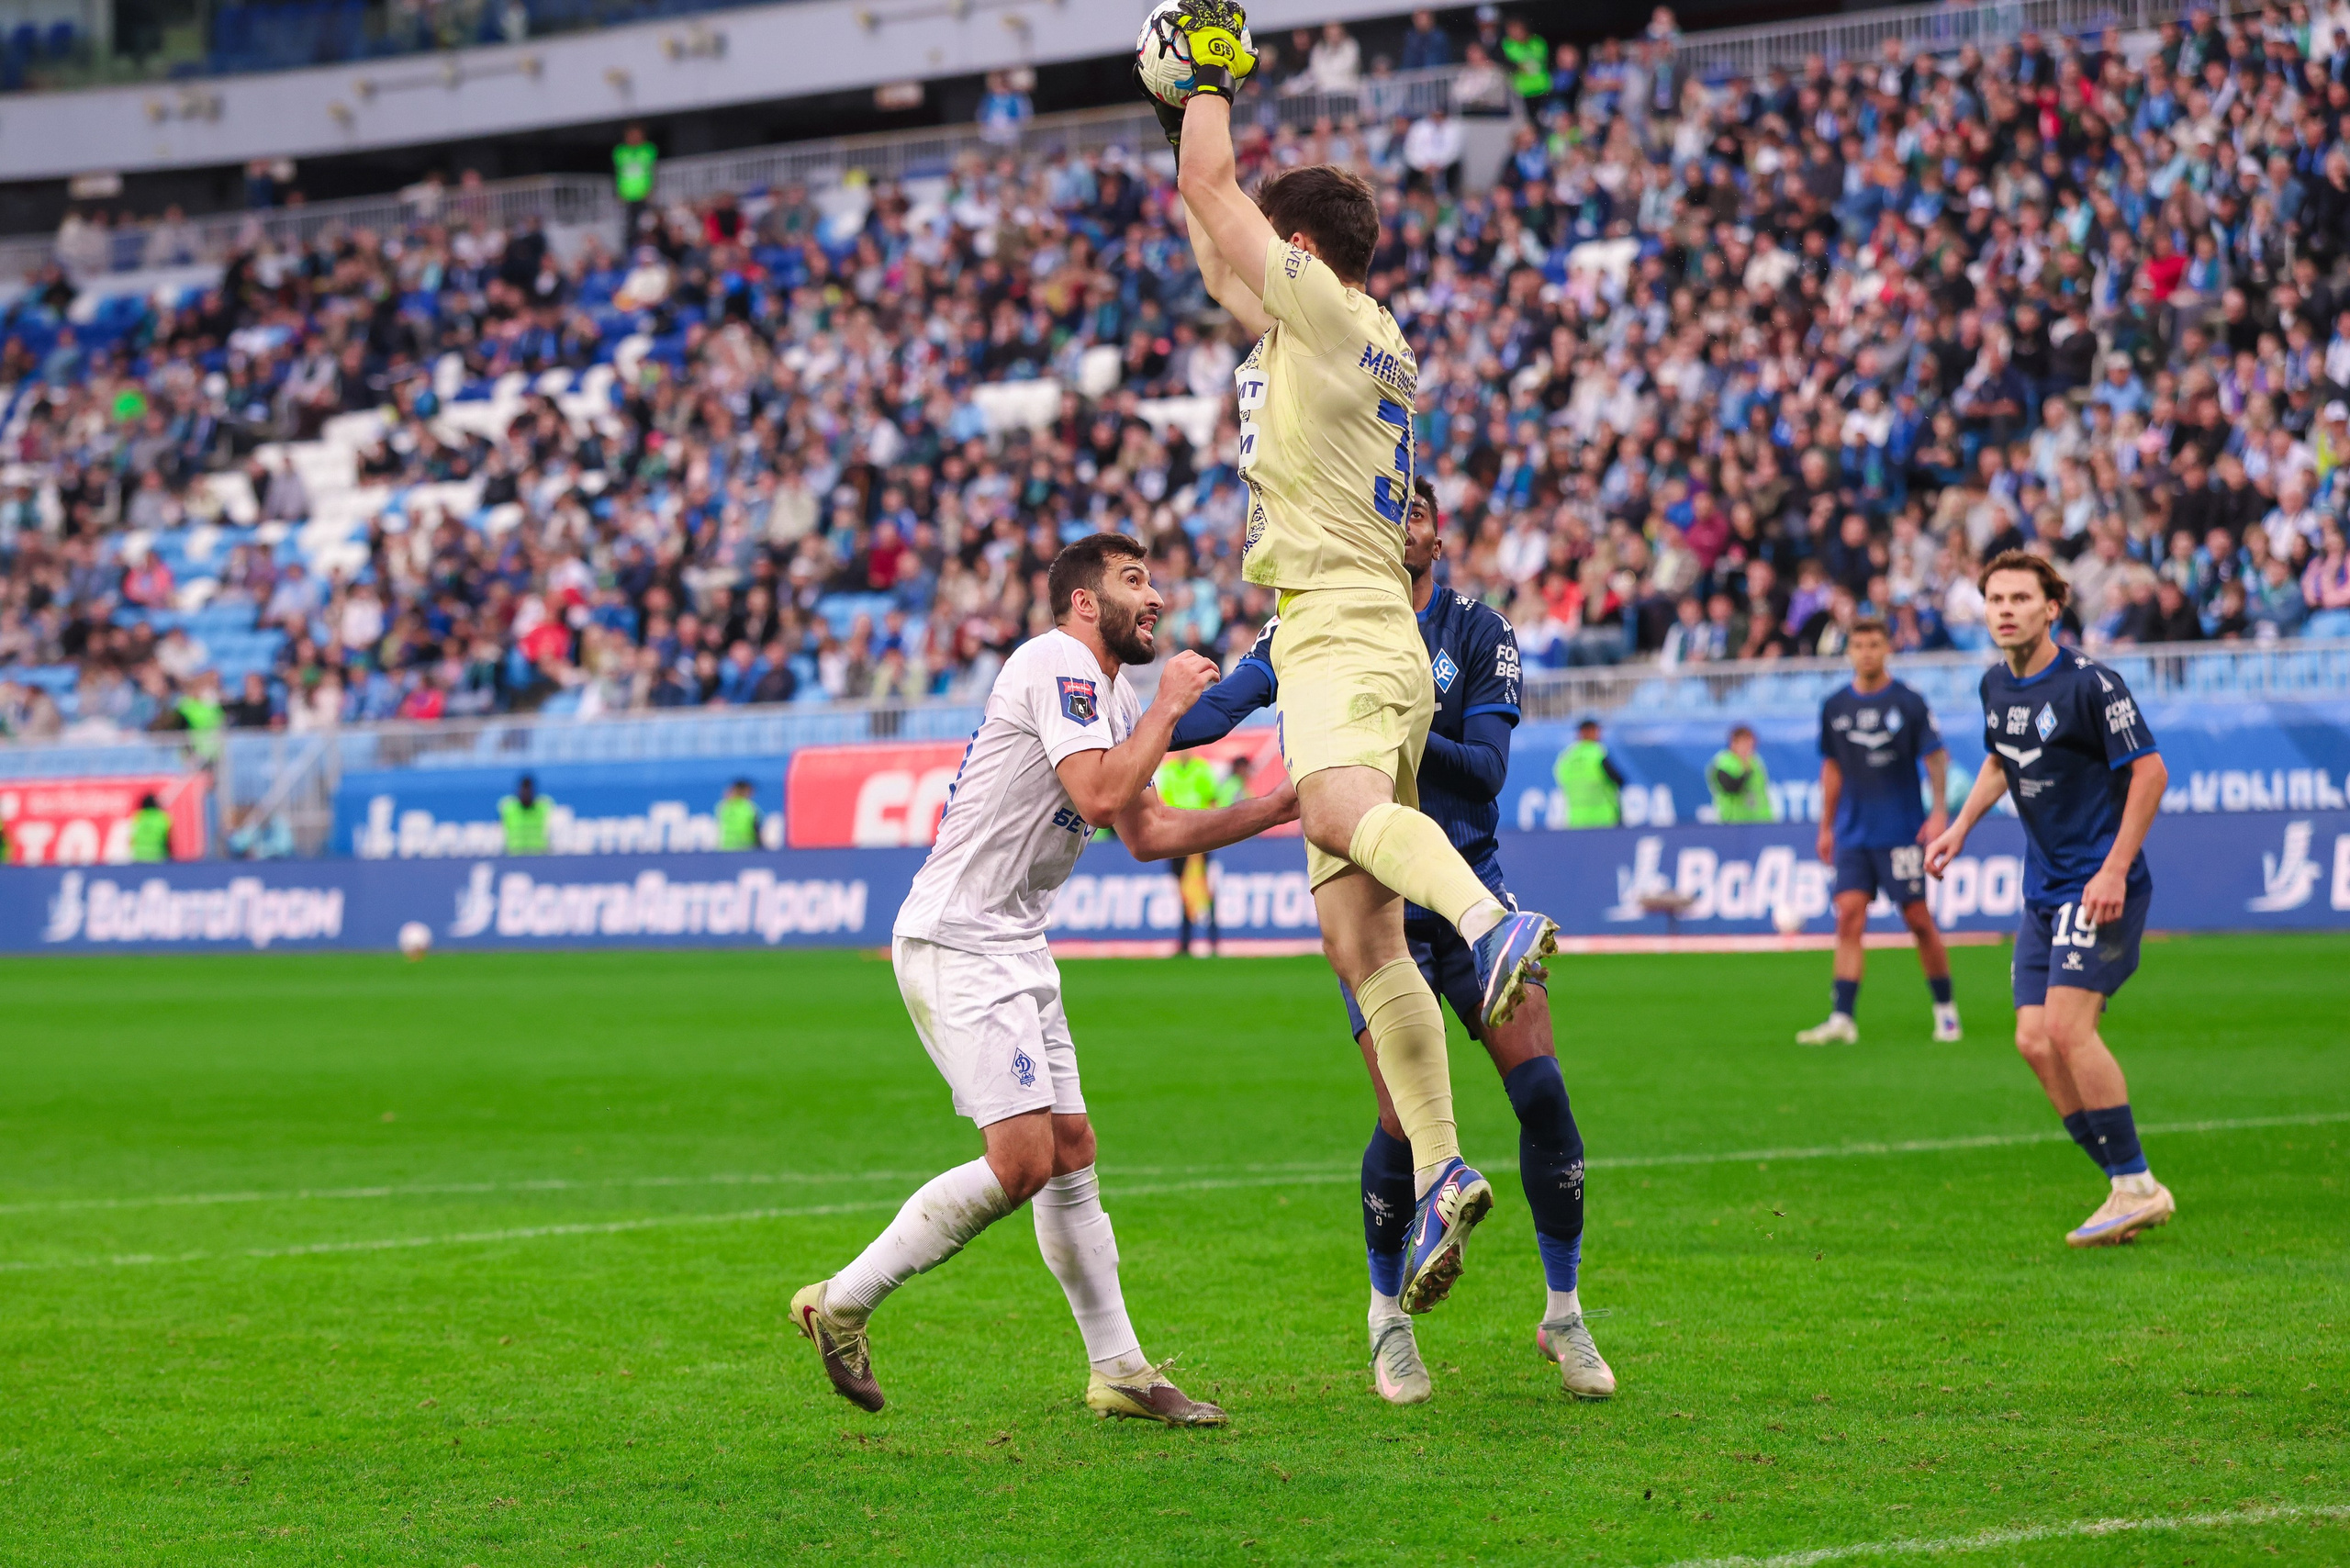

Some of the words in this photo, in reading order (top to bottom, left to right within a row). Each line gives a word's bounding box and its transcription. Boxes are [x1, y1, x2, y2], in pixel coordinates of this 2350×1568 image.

[1374, 398, 1416, 526] 3
[496, 868, 869, 946] ВолгаАвтоПром
[2052, 902, 2098, 949] 19
